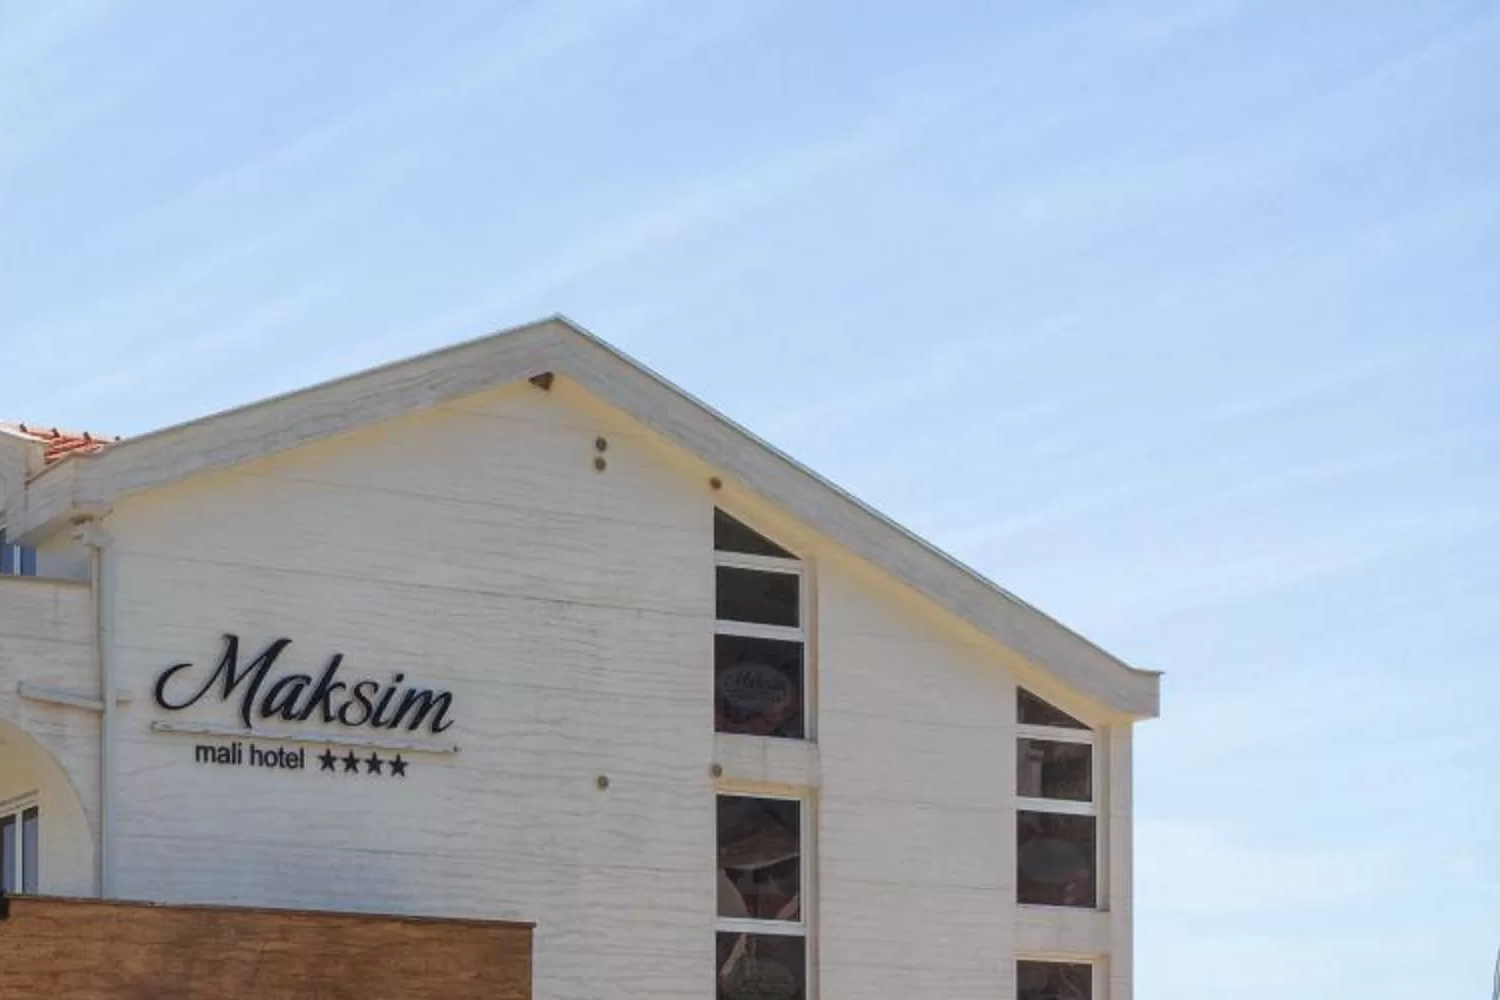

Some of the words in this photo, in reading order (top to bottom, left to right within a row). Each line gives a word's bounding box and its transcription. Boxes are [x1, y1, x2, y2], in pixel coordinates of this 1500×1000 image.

[155, 633, 455, 733] Maksim
[195, 742, 242, 765] mali
[250, 744, 304, 769] hotel
